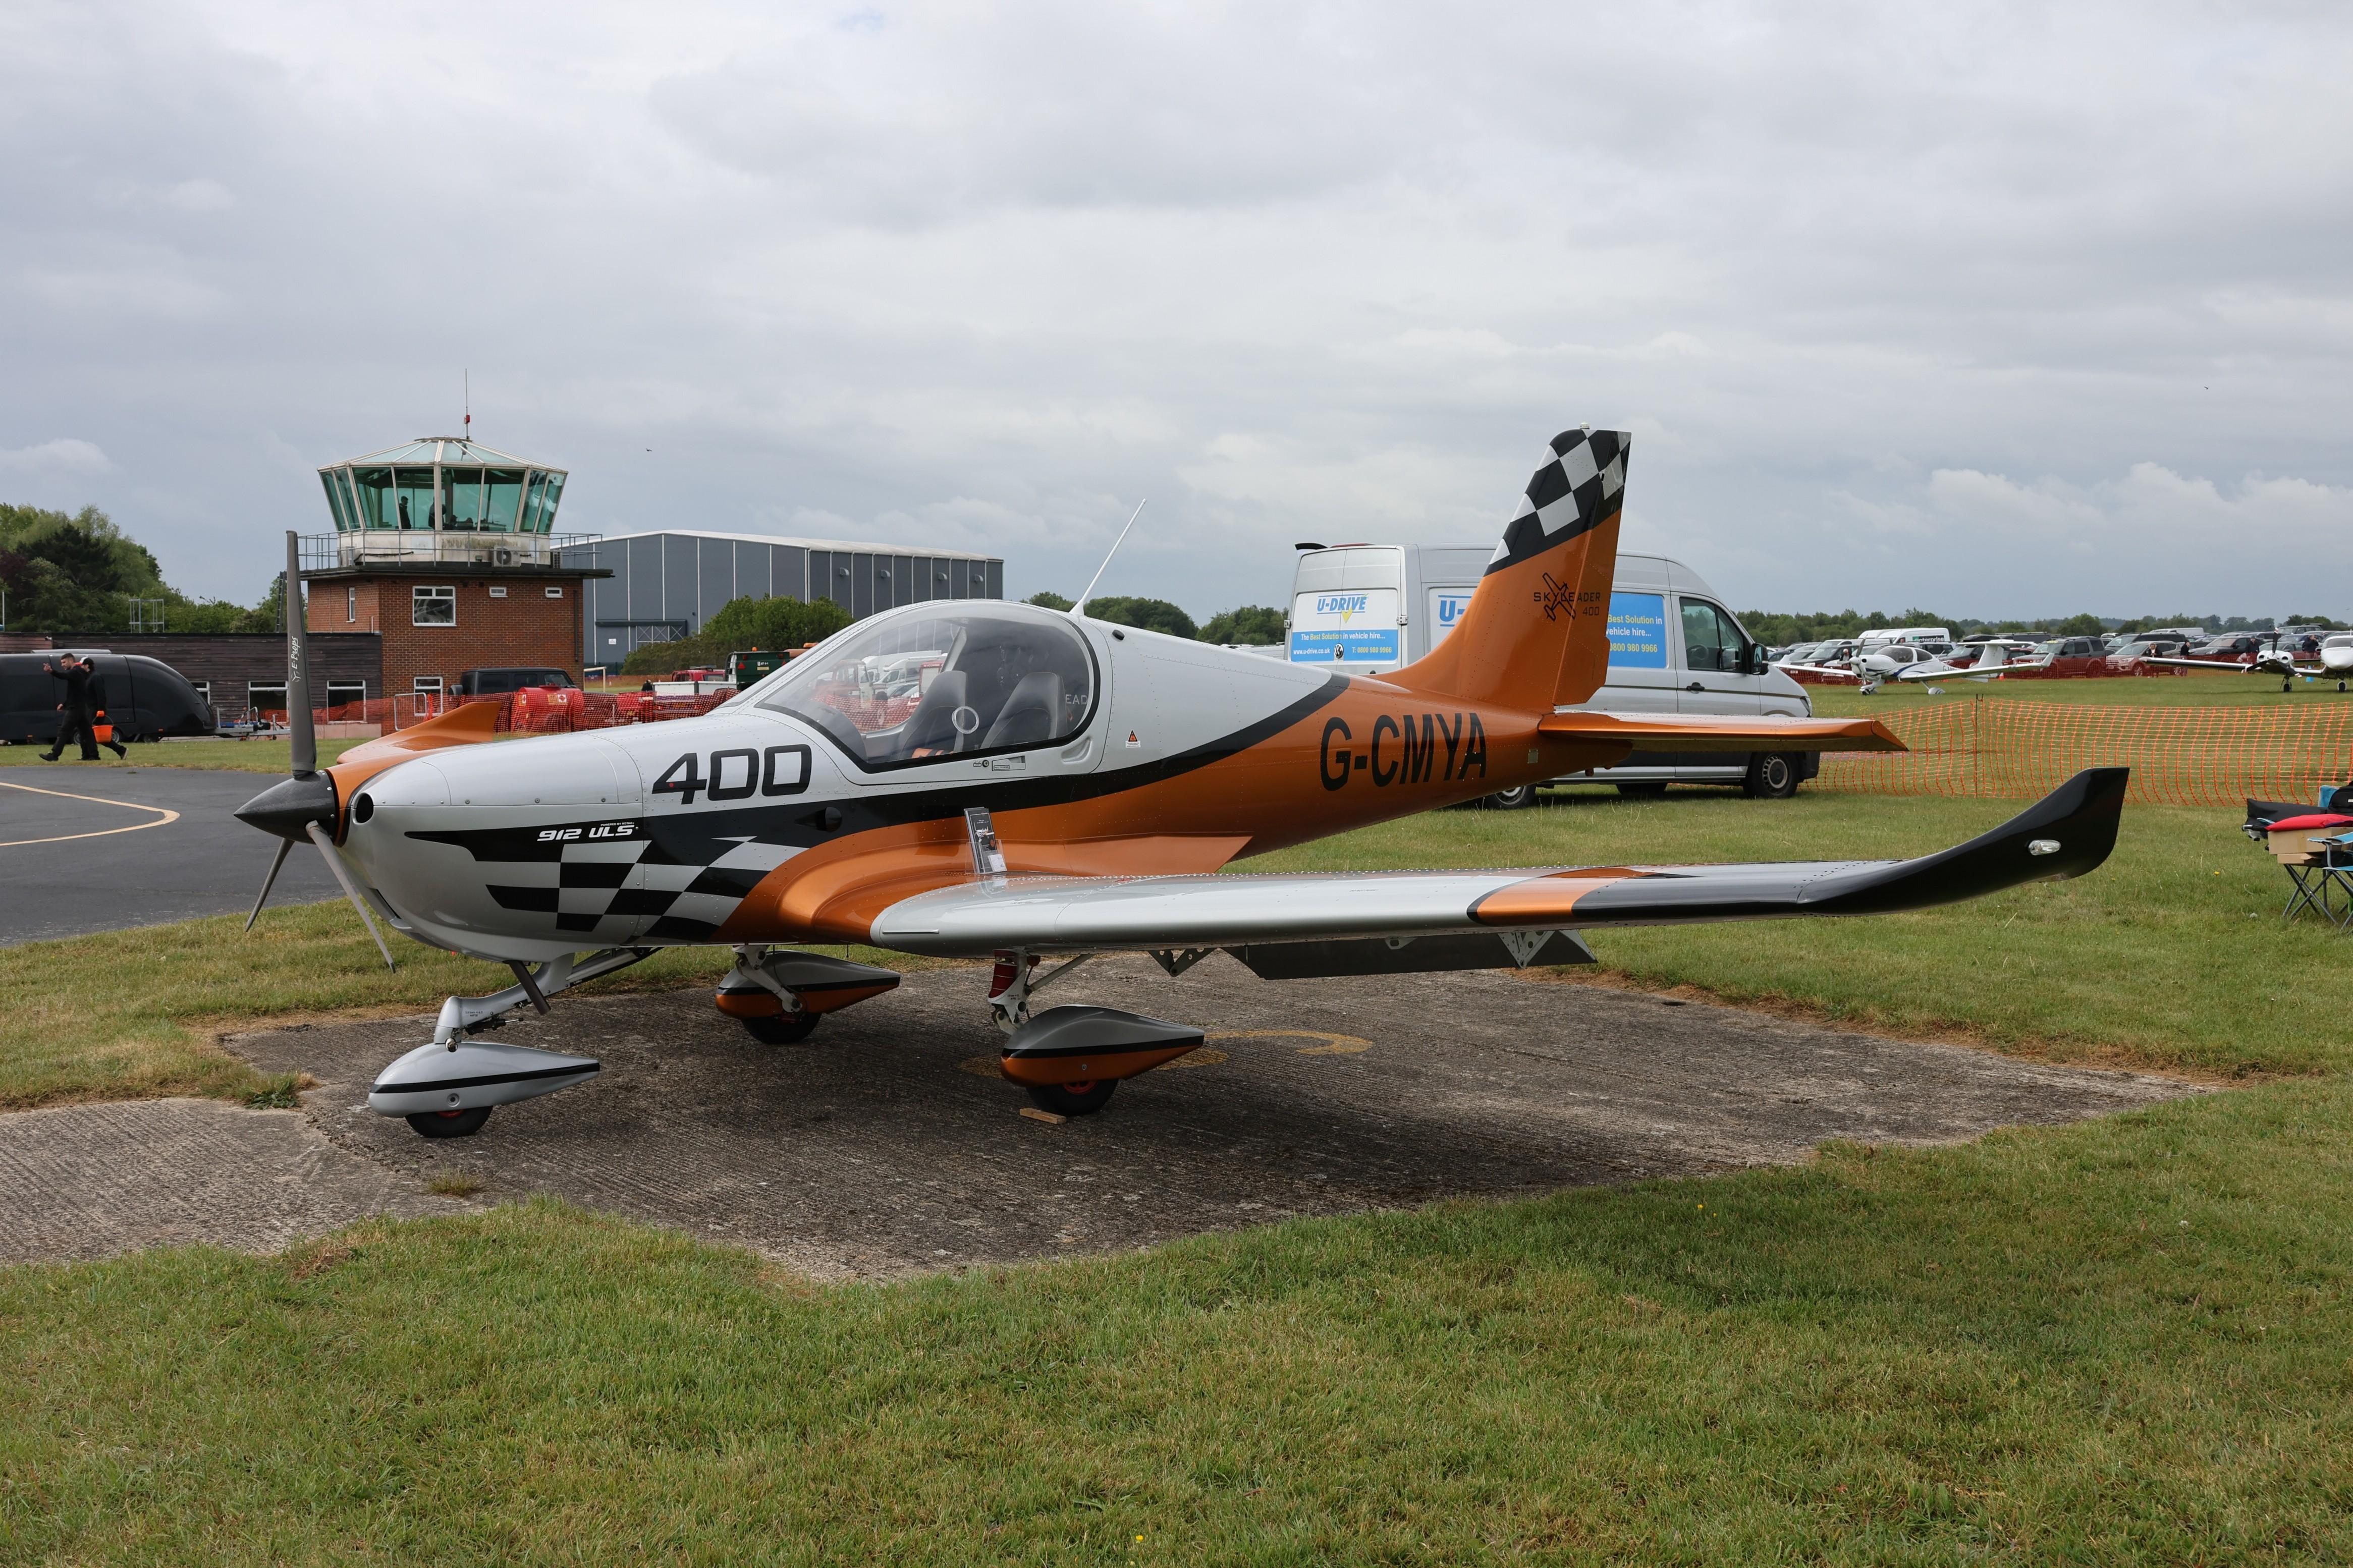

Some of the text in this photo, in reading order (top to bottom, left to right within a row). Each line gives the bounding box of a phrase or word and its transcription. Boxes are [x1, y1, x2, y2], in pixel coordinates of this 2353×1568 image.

[1534, 592, 1601, 602] SKYLEADER
[1317, 597, 1367, 611] U-DRIVE
[1582, 606, 1600, 616] 400
[1608, 614, 1663, 625] Best Solution in
[1606, 627, 1652, 637] vehicle hire...
[1610, 643, 1658, 653] 0800 980 9966
[1320, 712, 1487, 792] G-CMYA
[652, 744, 812, 805] 400
[536, 825, 635, 842] 912 ULS
